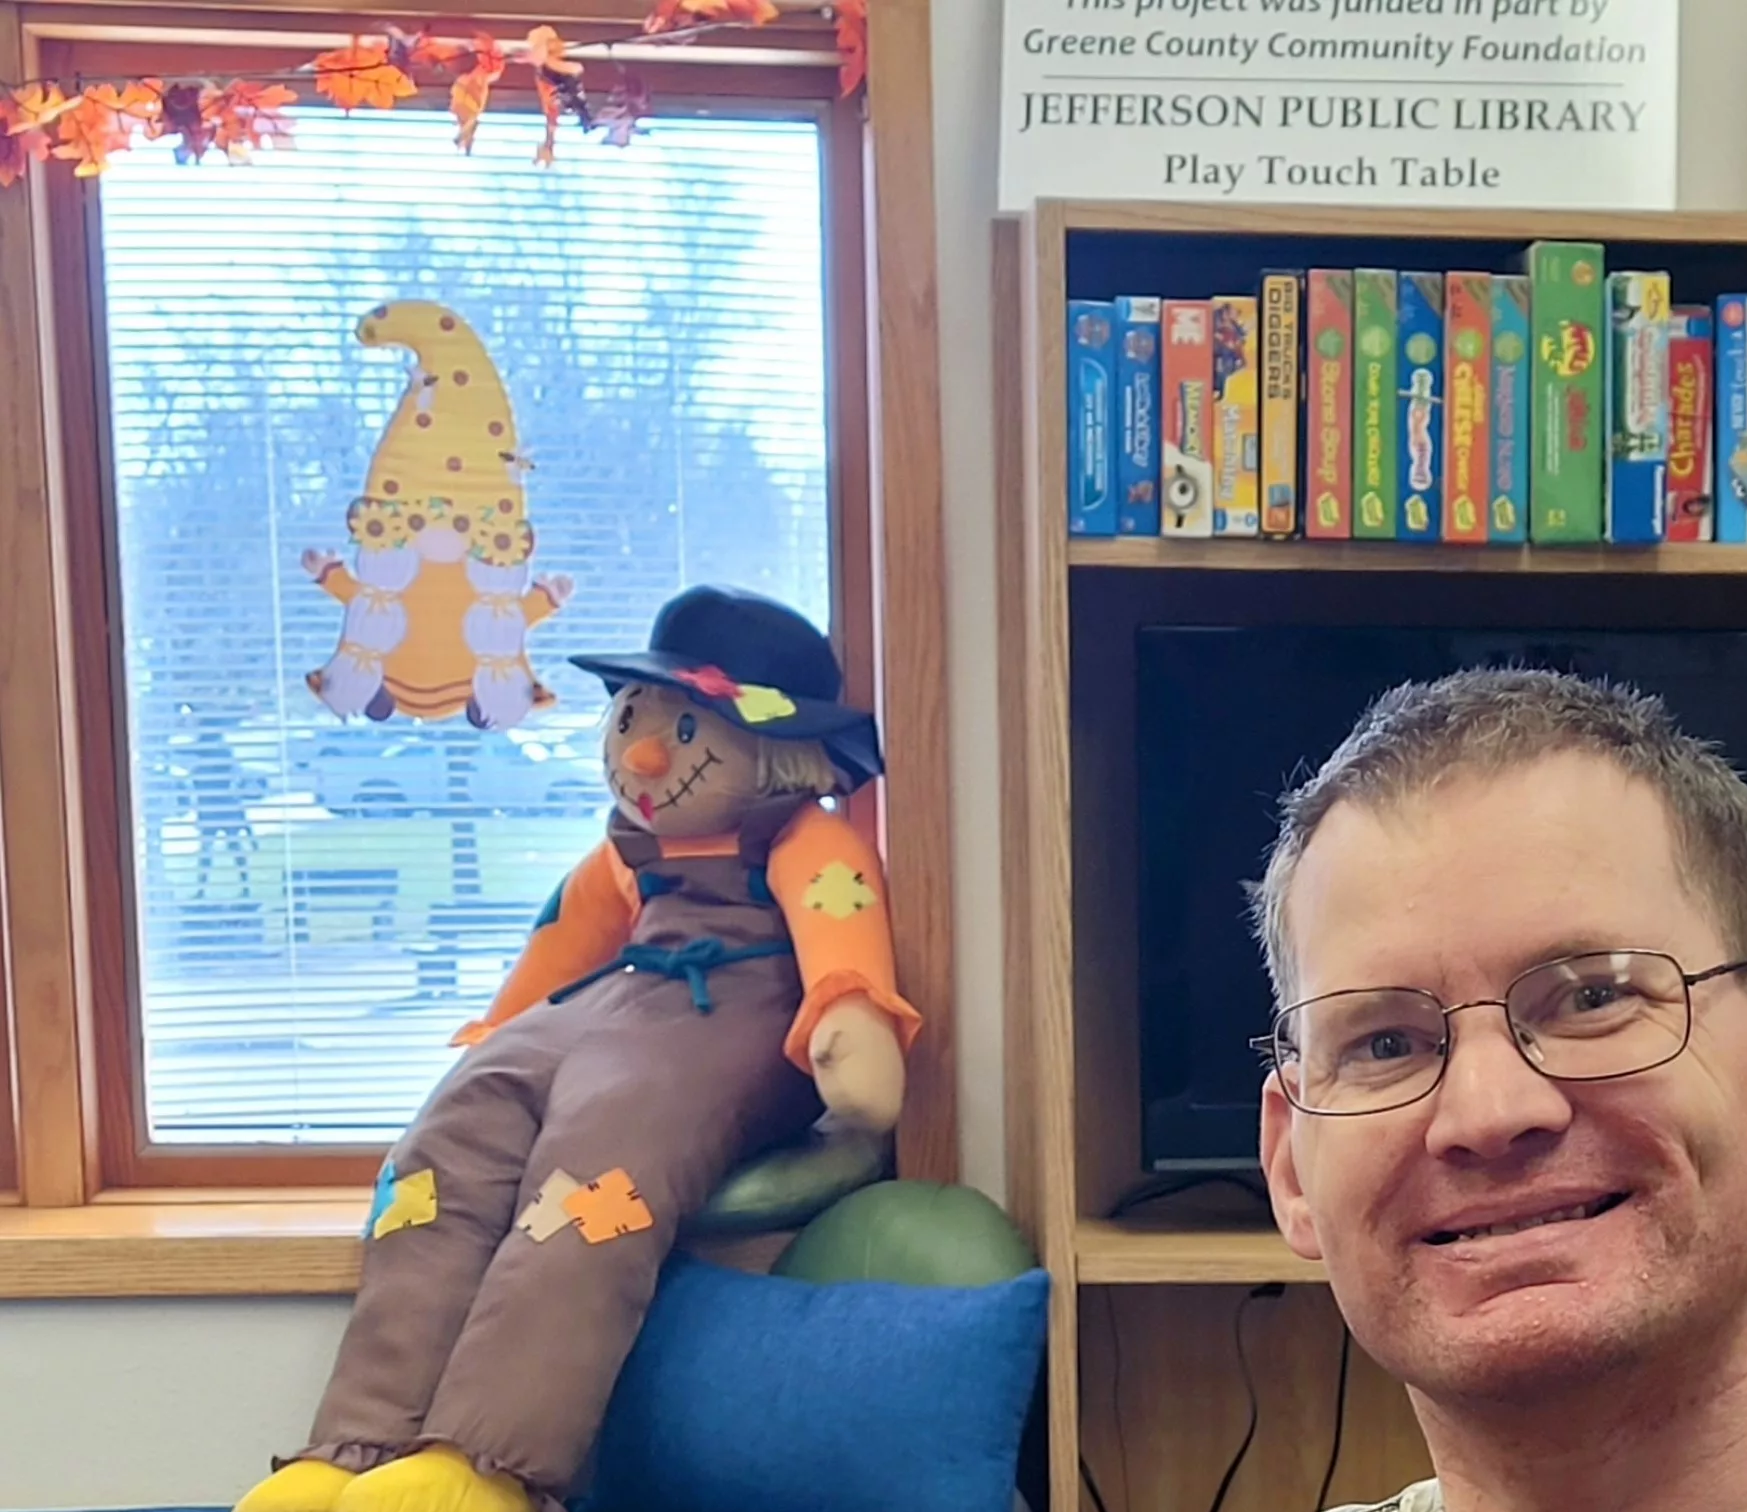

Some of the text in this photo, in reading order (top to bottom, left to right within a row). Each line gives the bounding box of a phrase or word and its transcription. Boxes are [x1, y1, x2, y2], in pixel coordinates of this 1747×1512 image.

[1023, 28, 1647, 67] Greene County Community Foundation
[1019, 93, 1647, 133] JEFFERSON PUBLIC LIBRARY
[1163, 153, 1501, 195] Play Touch Table
[1669, 361, 1697, 479] Charades
